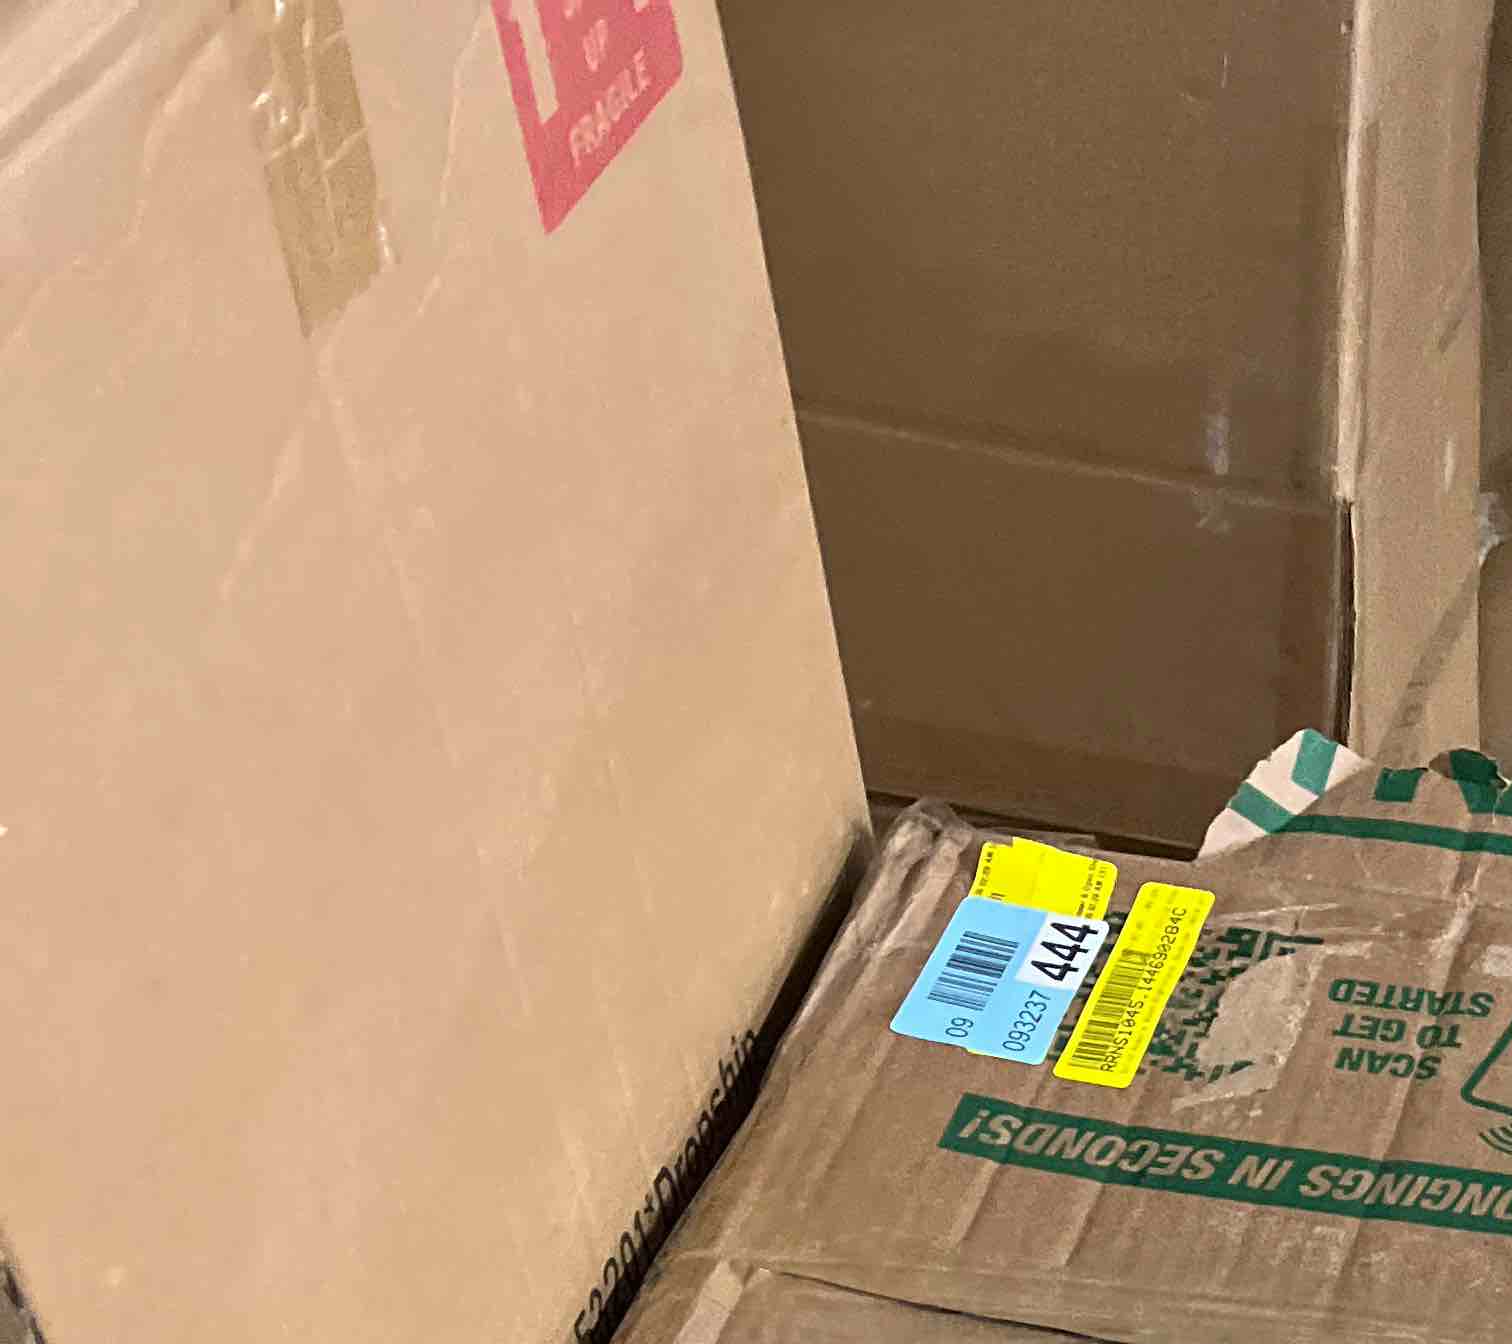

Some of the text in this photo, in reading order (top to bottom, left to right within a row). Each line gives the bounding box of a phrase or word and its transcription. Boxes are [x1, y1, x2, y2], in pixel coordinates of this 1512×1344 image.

[568, 47, 651, 169] FRAGILE
[1002, 921, 1099, 1053] 093237 444
[1326, 977, 1496, 1019] STARTED
[945, 1016, 974, 1039] 09
[1332, 1012, 1463, 1050] TO GET
[1332, 1046, 1442, 1081] SCAN
[957, 1108, 1225, 1182] SECONDS!
[1227, 1154, 1295, 1192] IN
